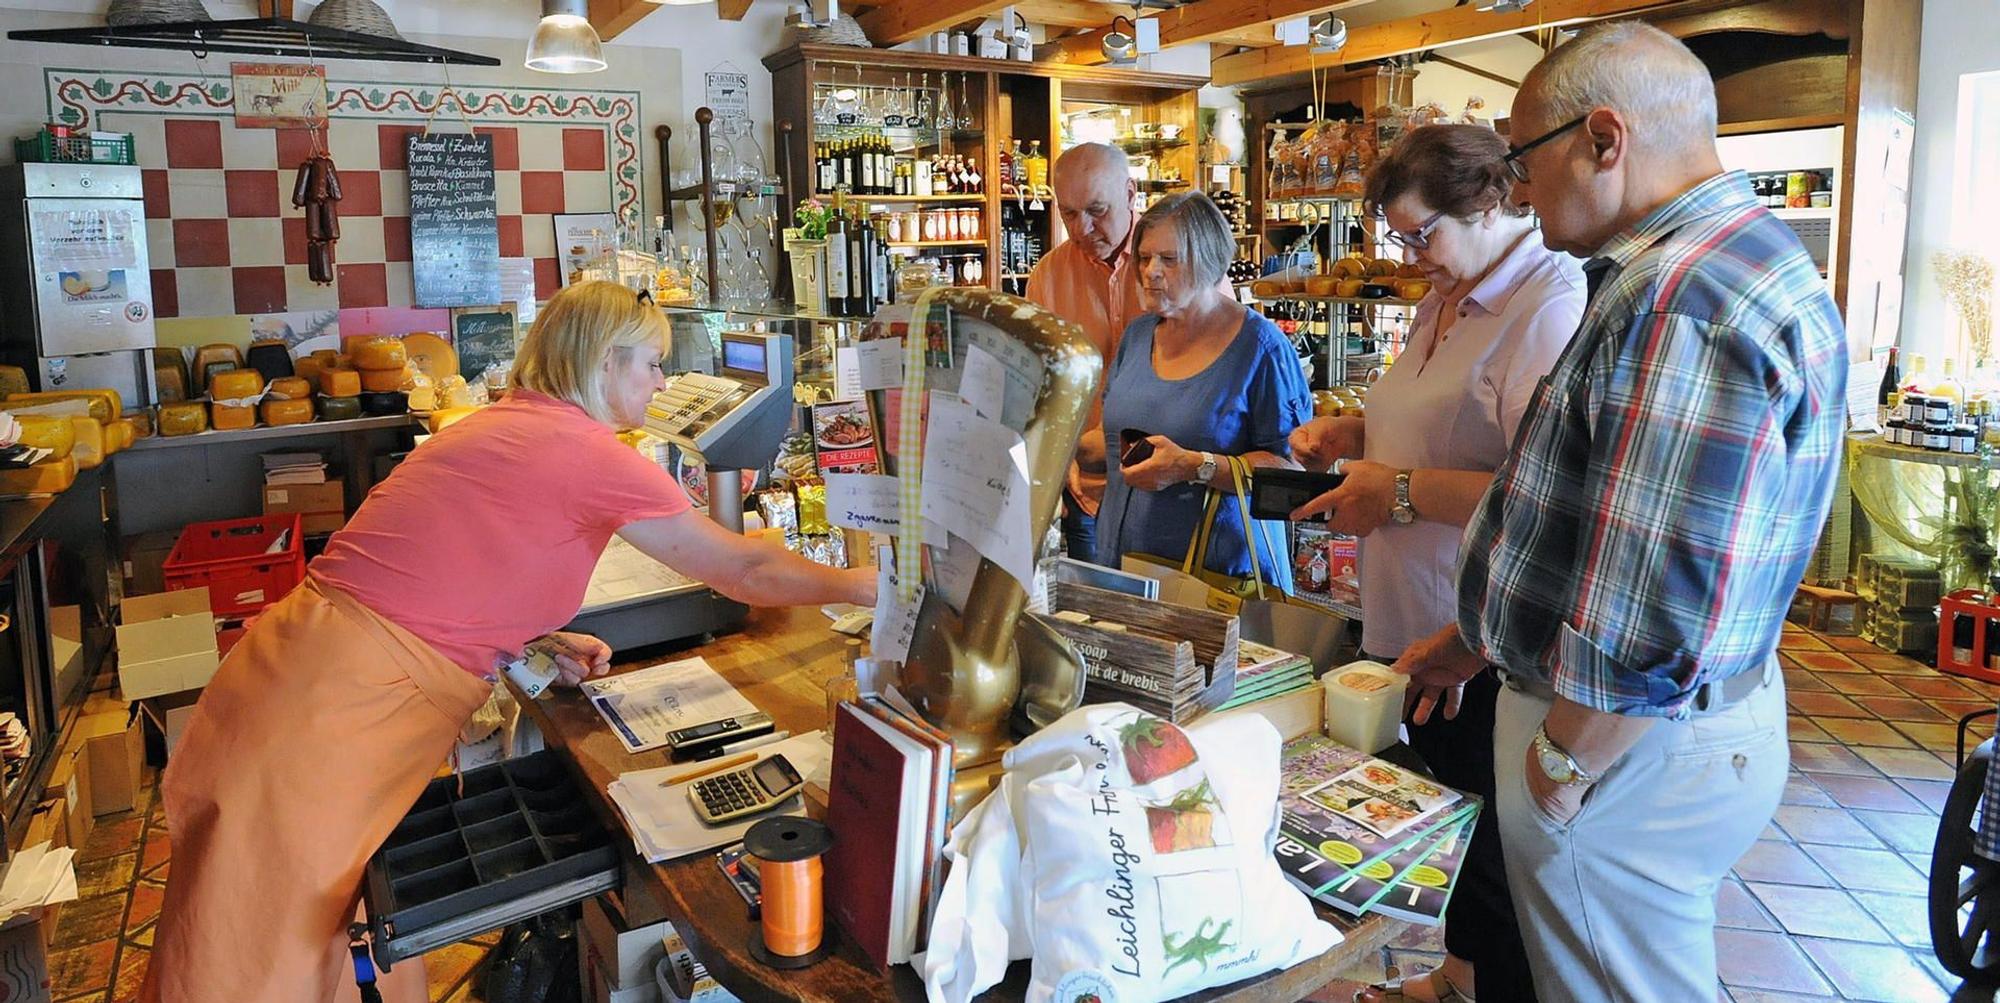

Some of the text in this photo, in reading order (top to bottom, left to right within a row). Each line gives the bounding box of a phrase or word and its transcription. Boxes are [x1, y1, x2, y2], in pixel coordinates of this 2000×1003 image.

[841, 451, 870, 460] REZEPTE
[1080, 643, 1107, 661] soap
[1104, 665, 1118, 680] de
[1122, 669, 1160, 692] brebis
[527, 684, 541, 698] 50
[1107, 828, 1141, 977] Leichlinger
